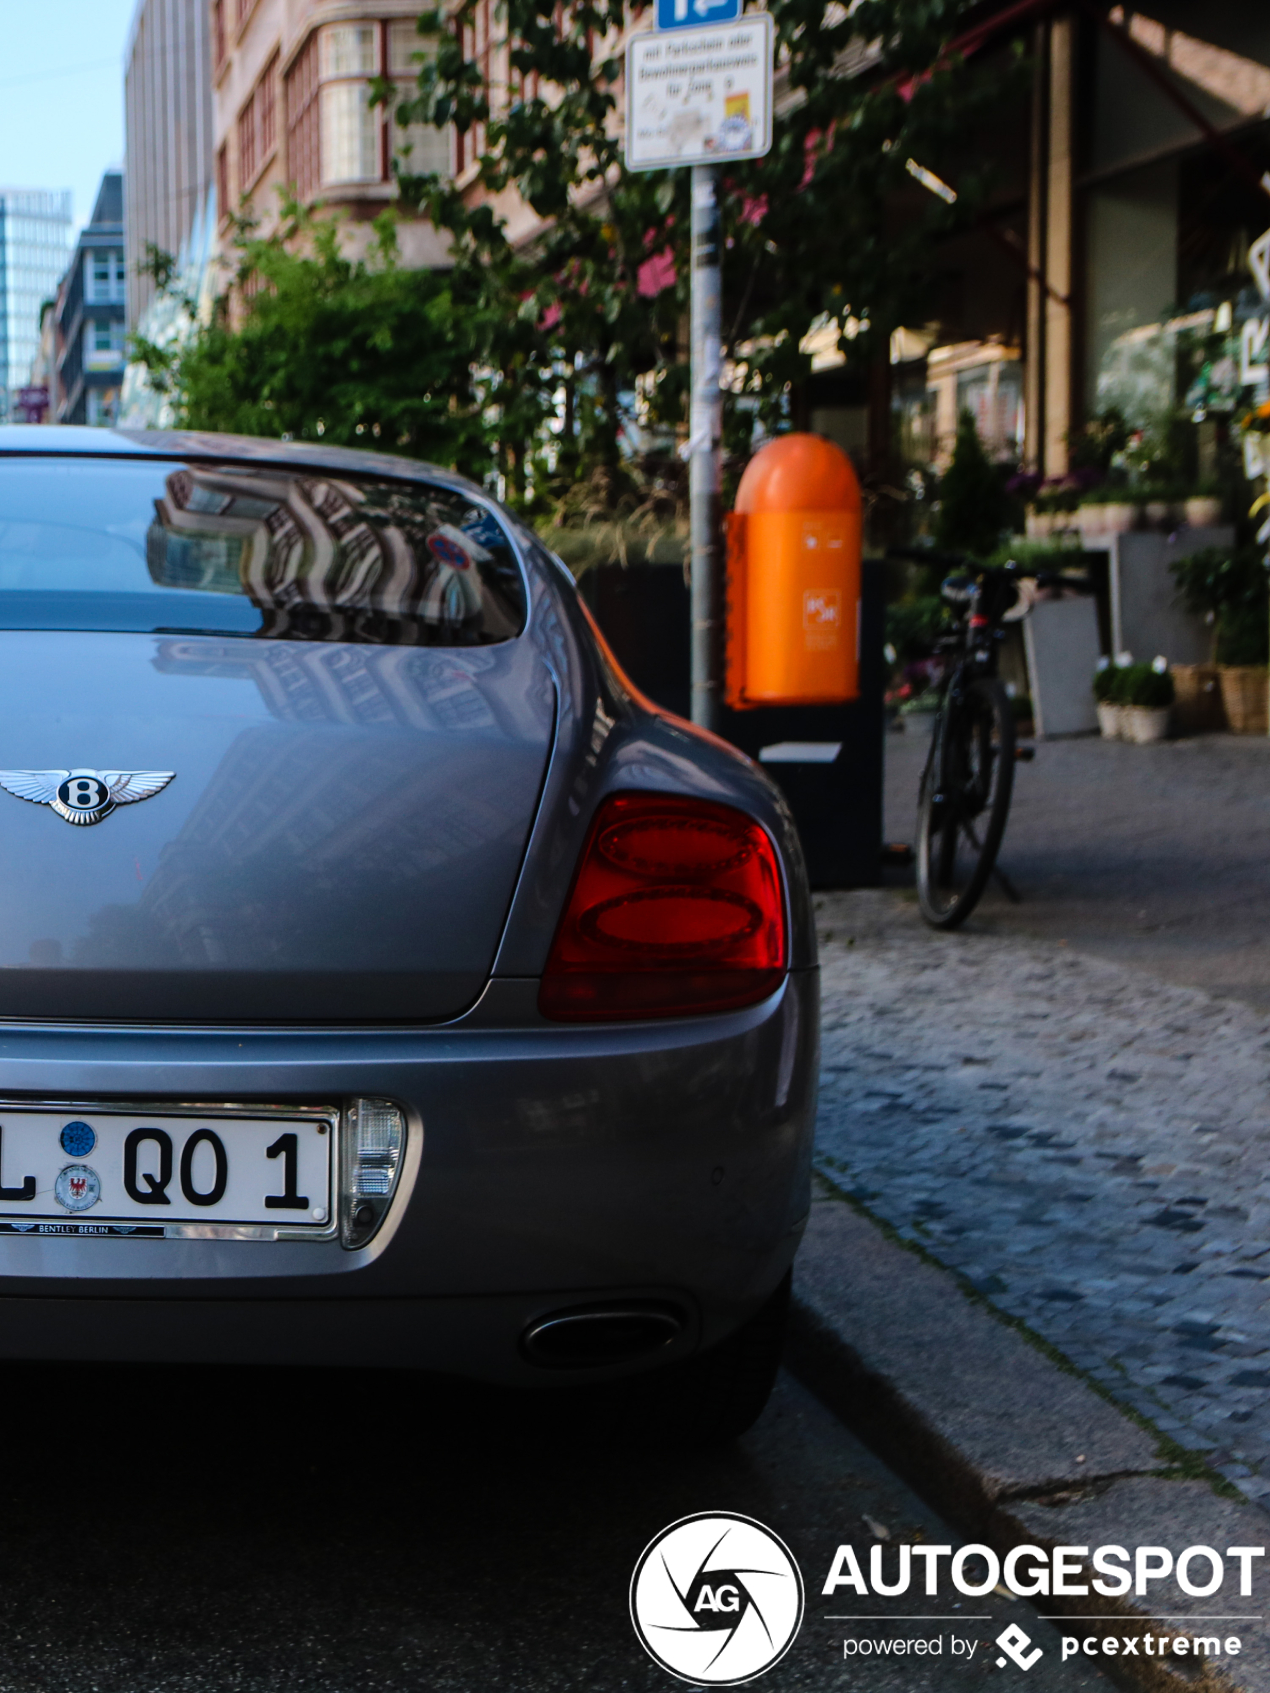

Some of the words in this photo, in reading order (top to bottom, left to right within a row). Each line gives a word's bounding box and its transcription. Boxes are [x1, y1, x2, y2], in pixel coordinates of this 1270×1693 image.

[66, 778, 100, 809] B
[264, 1132, 310, 1210] 1
[39, 1224, 77, 1233] BENTLEY
[78, 1225, 109, 1234] BERLIN
